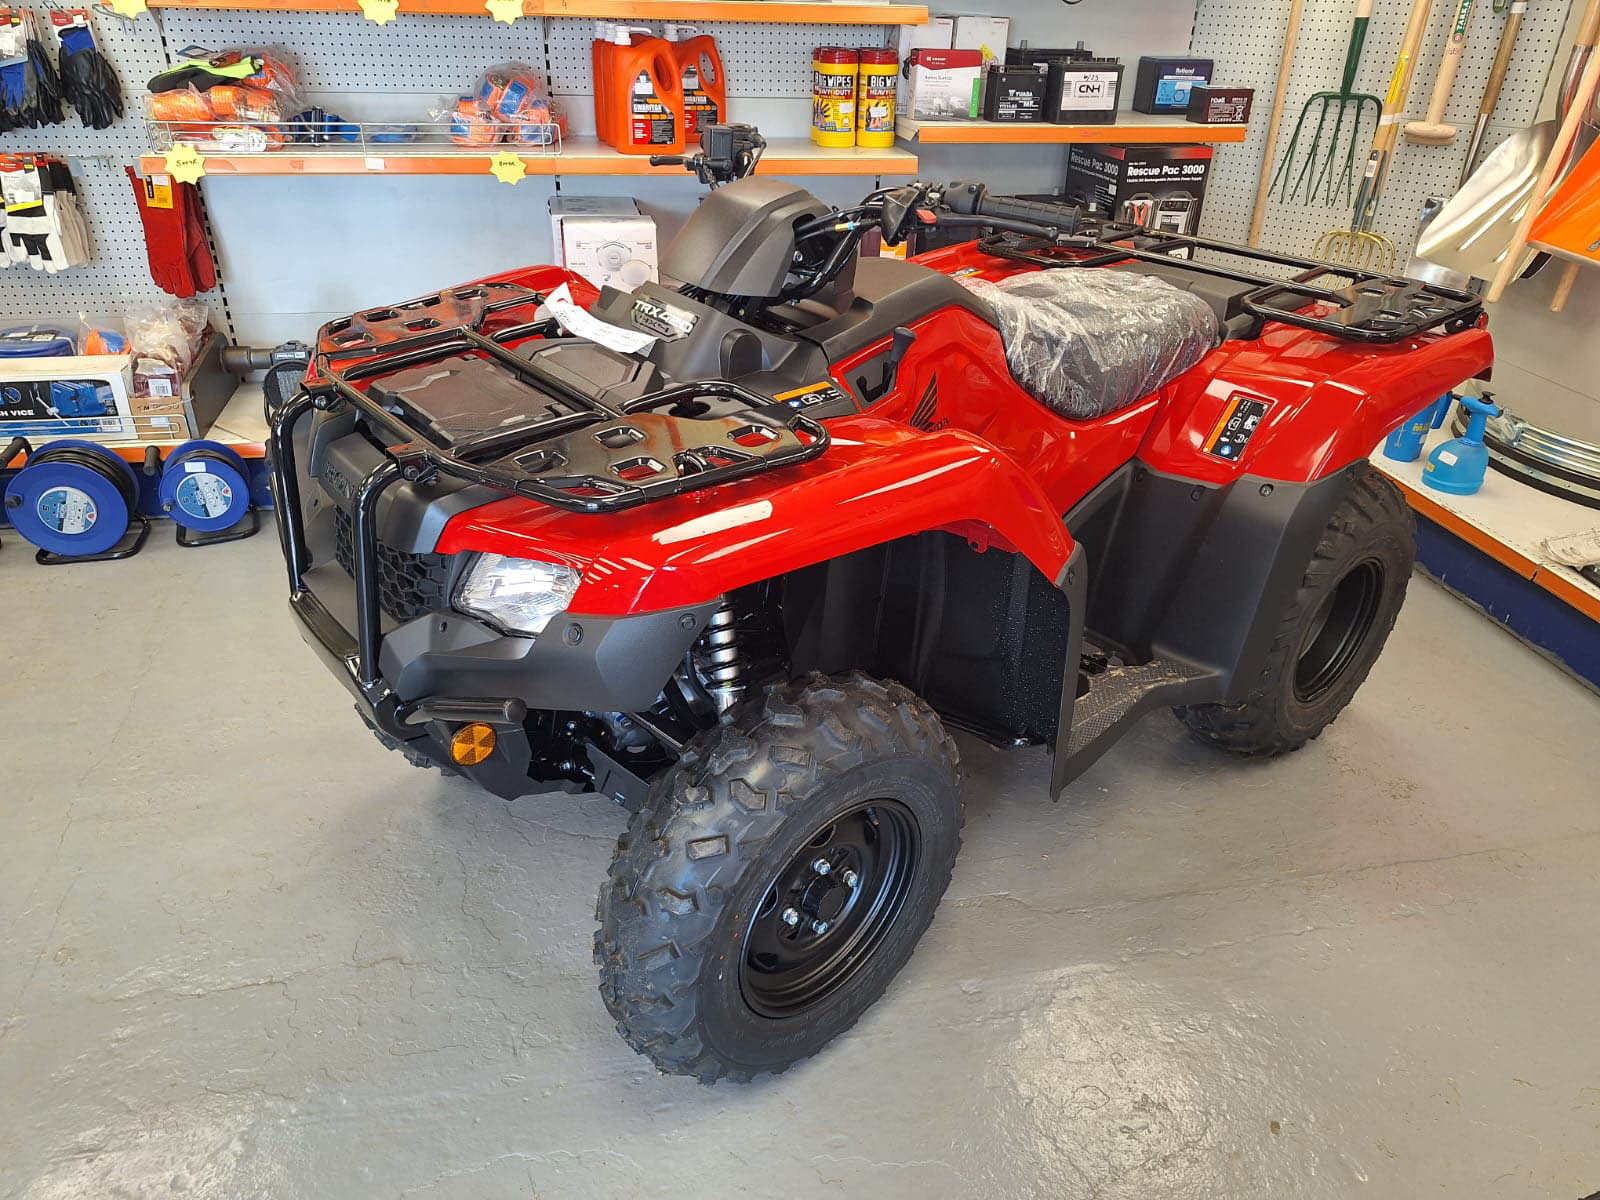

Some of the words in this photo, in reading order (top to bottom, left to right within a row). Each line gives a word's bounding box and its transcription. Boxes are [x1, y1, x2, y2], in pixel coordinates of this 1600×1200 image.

[827, 76, 851, 88] WIPES
[870, 76, 884, 87] BIG
[1079, 84, 1100, 93] CNH
[1072, 152, 1091, 167] Rescue
[1092, 158, 1103, 171] Pac
[1104, 162, 1119, 176] 3000
[1127, 166, 1160, 176] Rescue
[1162, 165, 1180, 175] Pac
[1181, 164, 1205, 175] 3000
